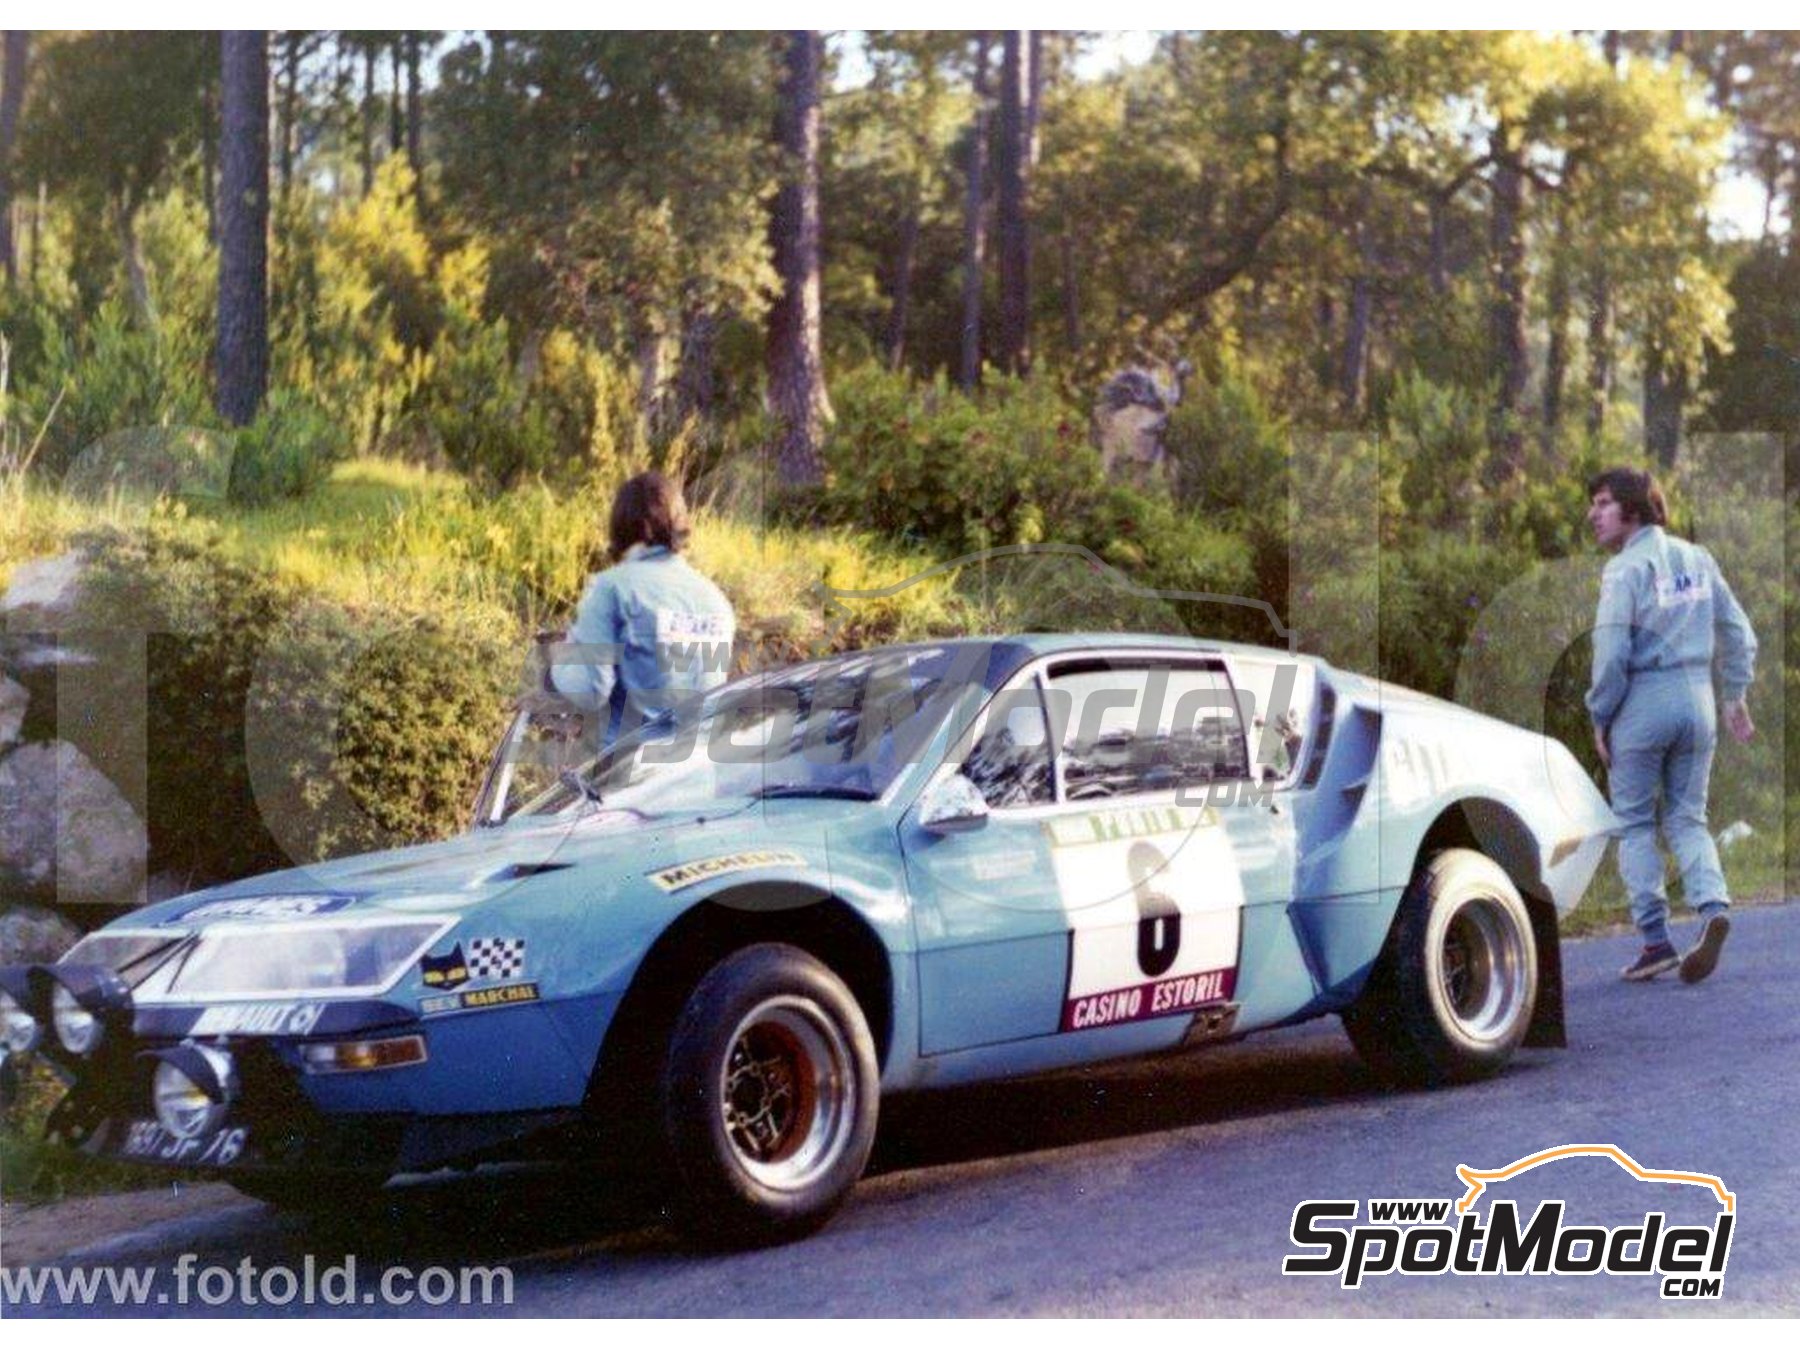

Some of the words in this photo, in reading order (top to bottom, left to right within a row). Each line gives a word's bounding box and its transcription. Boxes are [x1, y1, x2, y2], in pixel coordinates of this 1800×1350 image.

[1127, 840, 1182, 977] 6
[463, 985, 537, 1006] MARCHAL
[1073, 989, 1142, 1028] CASINO
[1152, 973, 1225, 1011] ESTORIL
